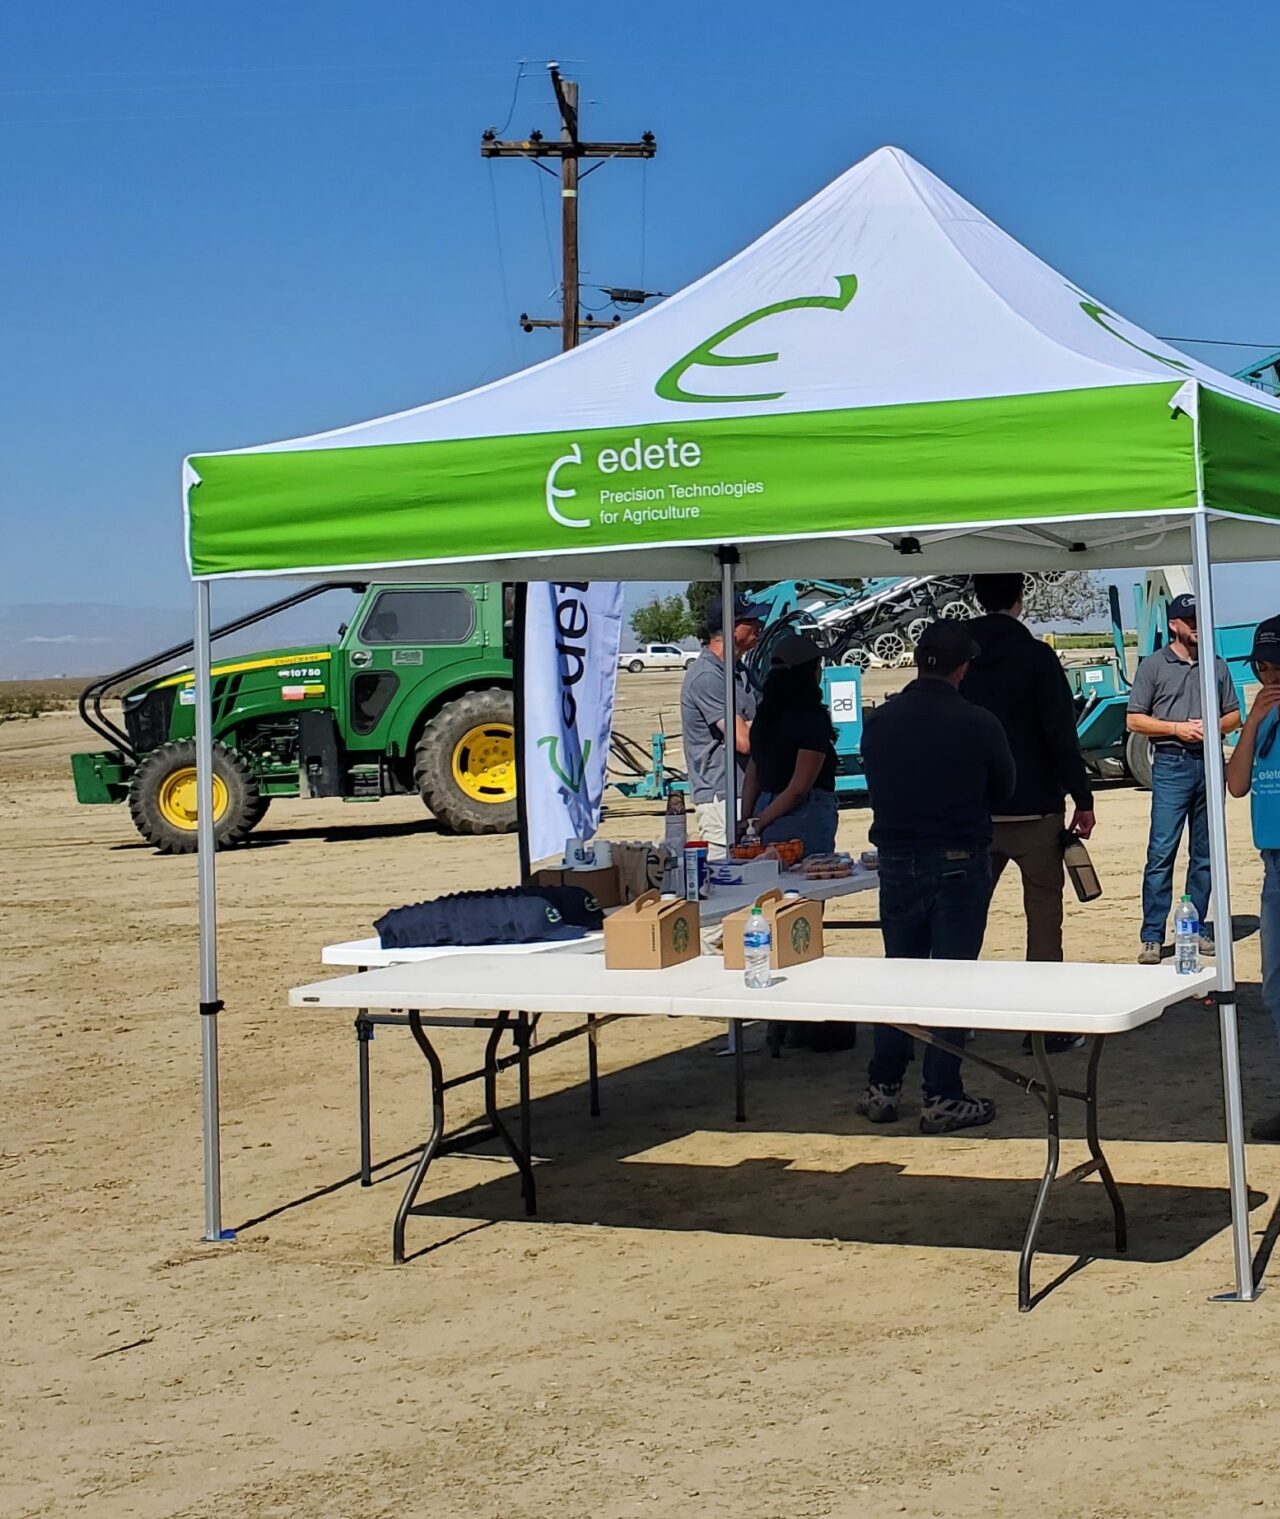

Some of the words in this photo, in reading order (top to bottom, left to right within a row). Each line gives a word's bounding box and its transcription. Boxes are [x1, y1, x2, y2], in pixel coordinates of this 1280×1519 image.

[598, 437, 701, 474] edete
[600, 487, 664, 504] Precision
[668, 480, 764, 498] Technologies
[600, 510, 619, 523] for
[622, 505, 700, 525] Agriculture
[291, 668, 321, 678] 10750
[833, 698, 853, 712] 28
